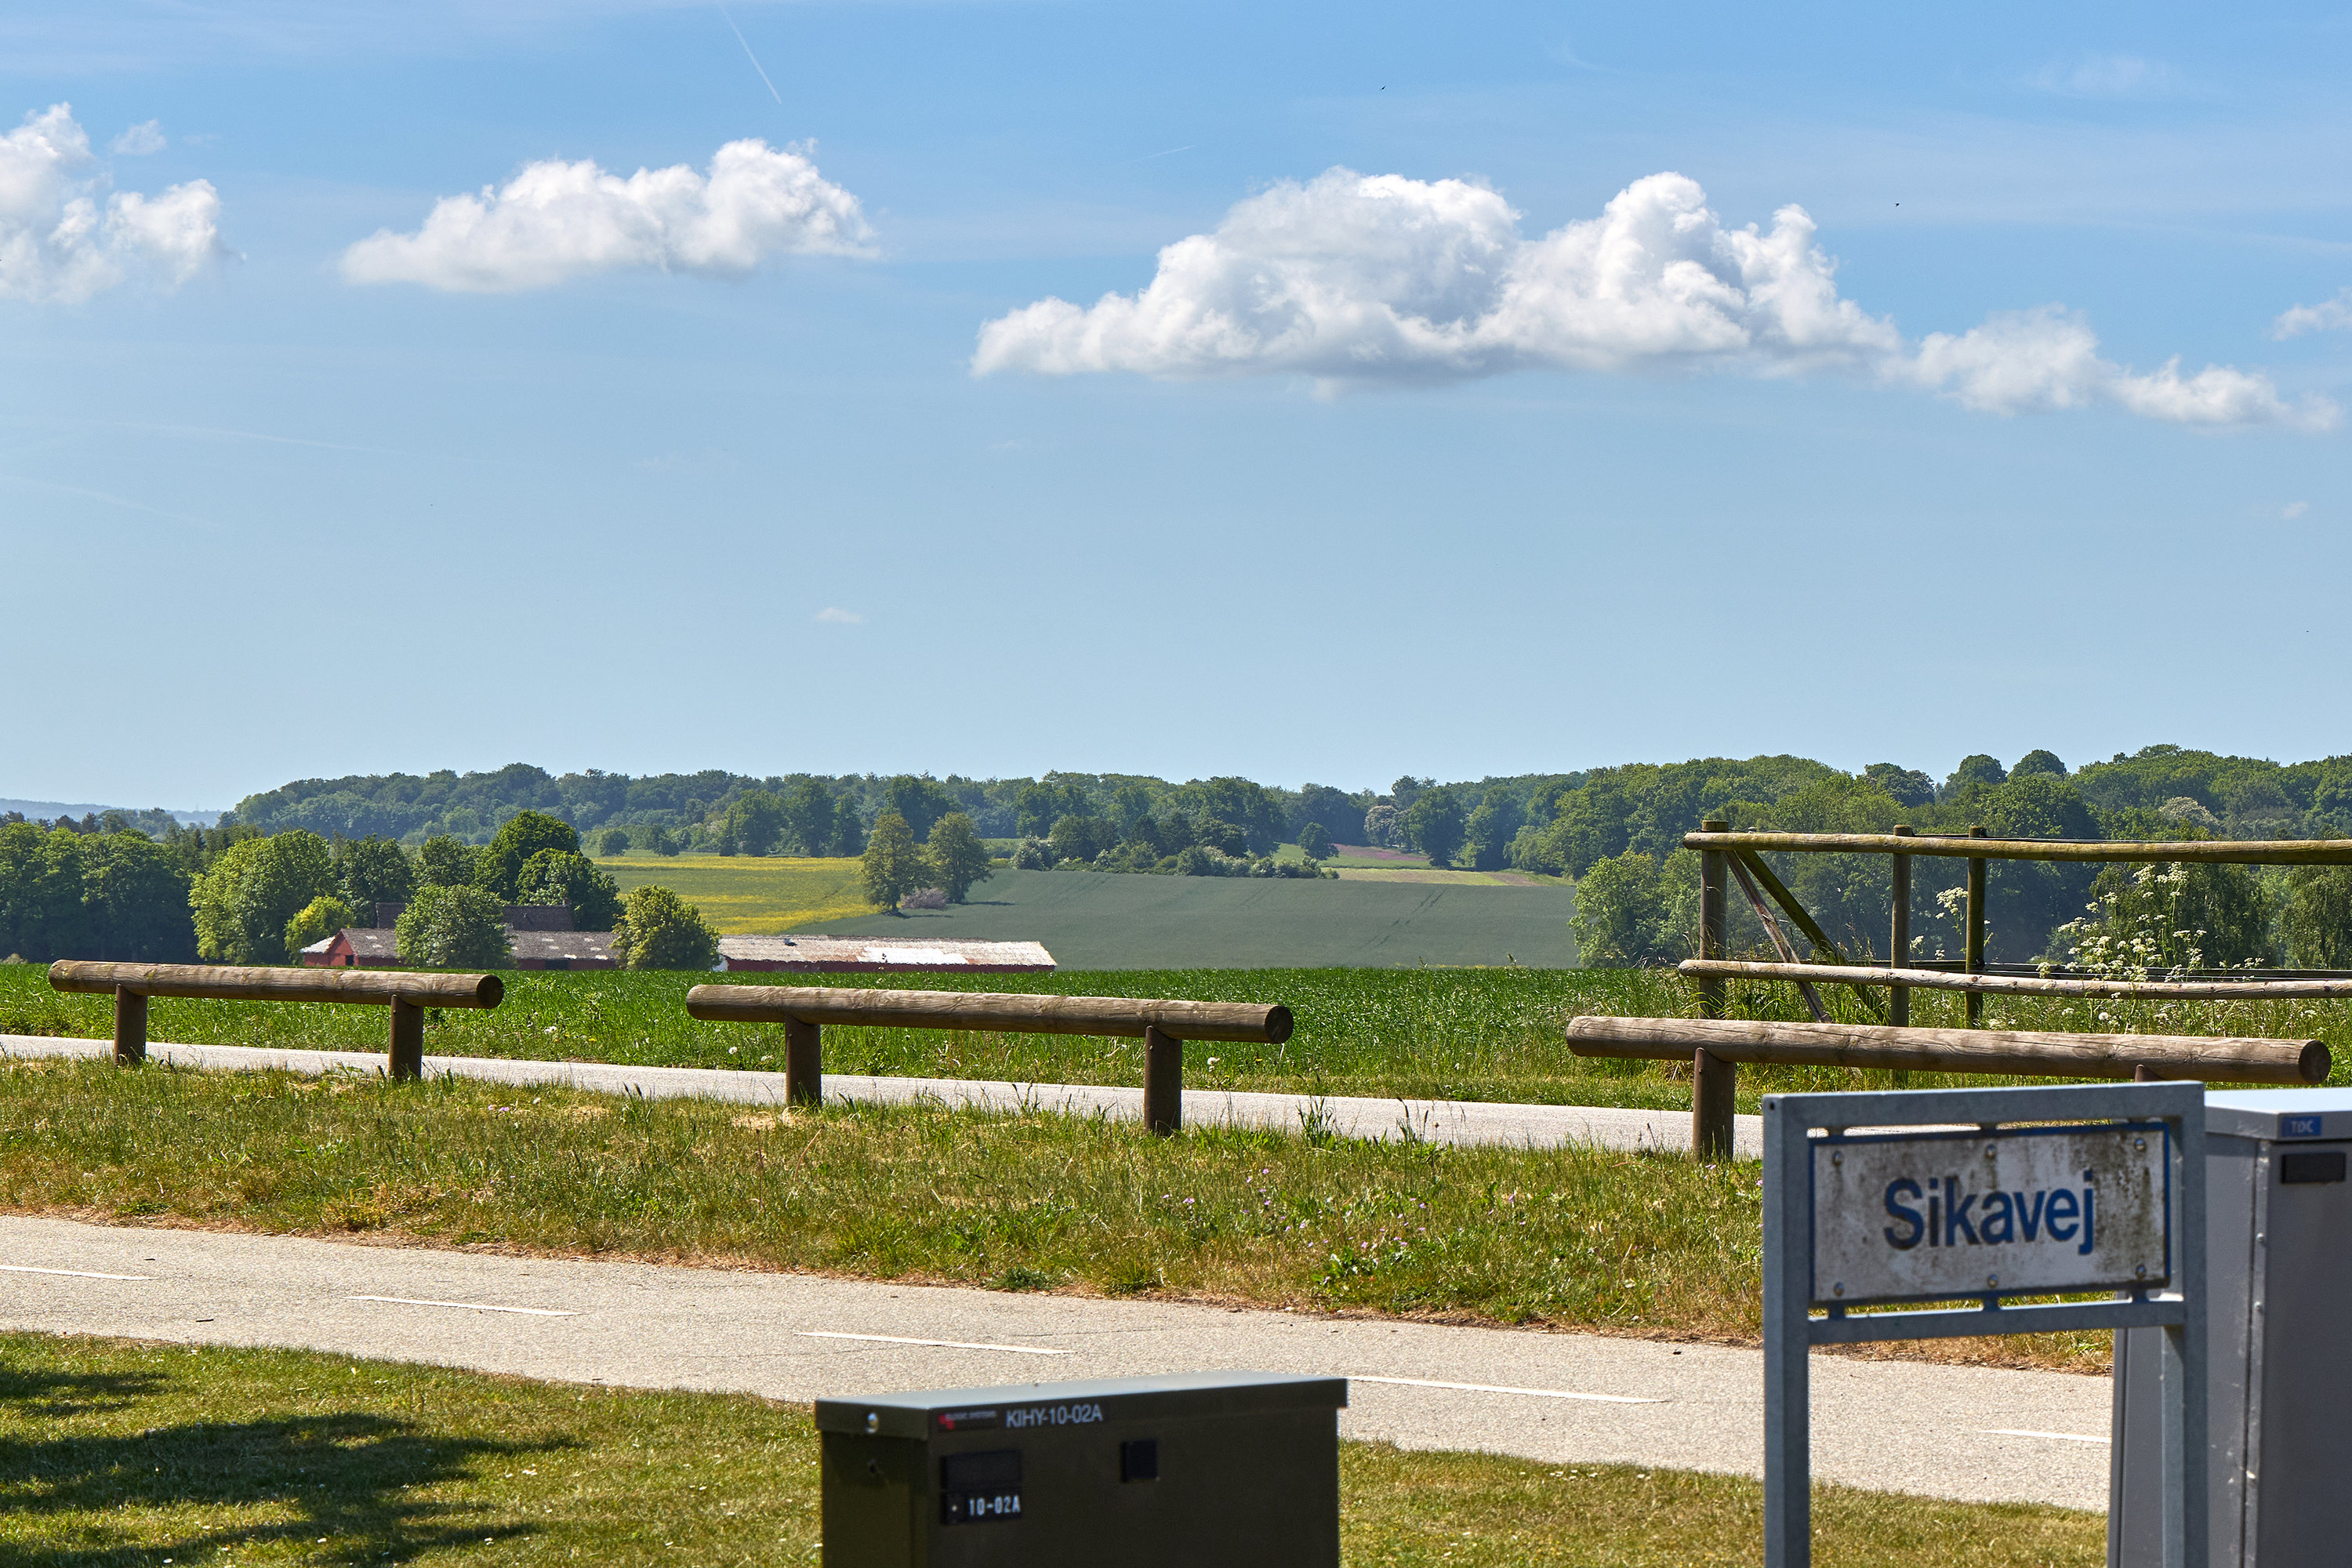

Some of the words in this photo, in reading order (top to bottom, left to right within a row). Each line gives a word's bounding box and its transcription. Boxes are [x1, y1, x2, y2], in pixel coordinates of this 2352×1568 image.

[2290, 1120, 2314, 1134] TDC
[1883, 1168, 2094, 1255] Sikavej
[1005, 1403, 1104, 1429] KIHY-10-02A
[968, 1494, 1022, 1516] 10-02A
